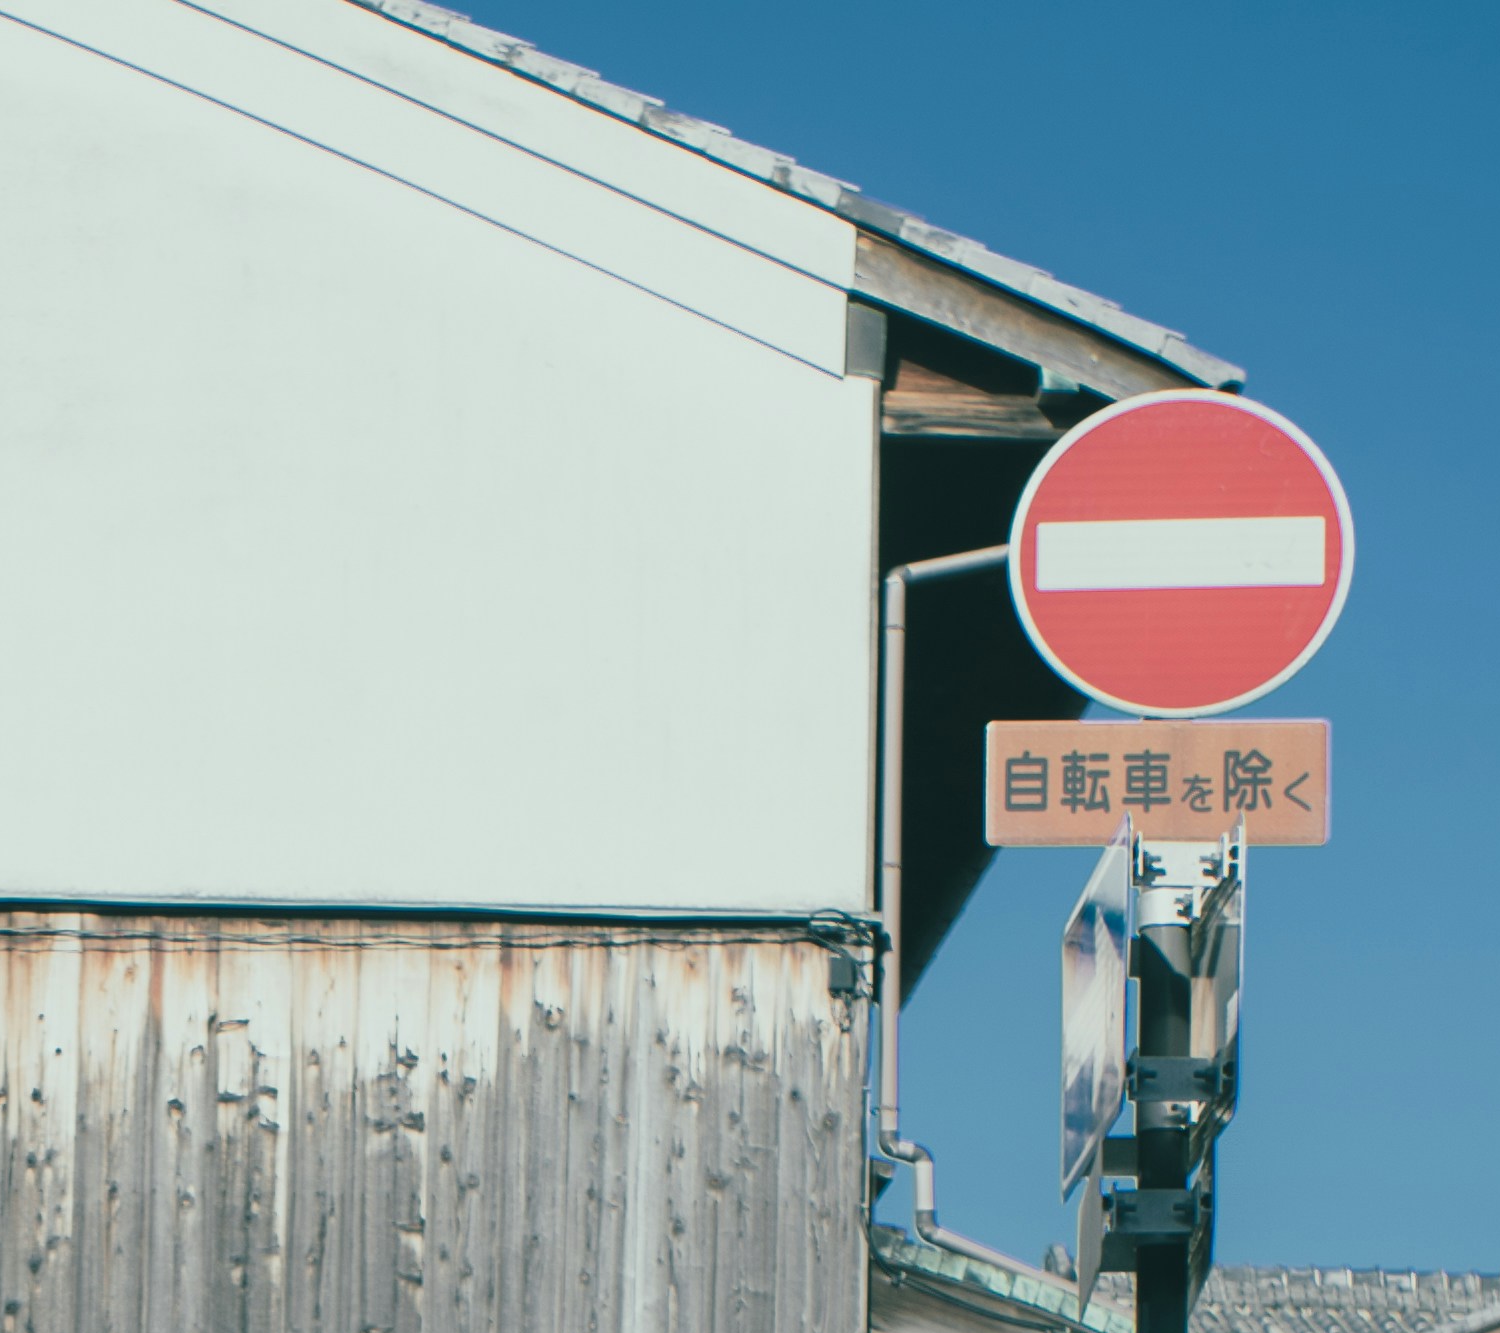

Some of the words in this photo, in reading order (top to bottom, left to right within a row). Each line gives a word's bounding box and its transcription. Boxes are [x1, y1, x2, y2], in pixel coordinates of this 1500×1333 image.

[1004, 750, 1312, 813] 自転車を除く
